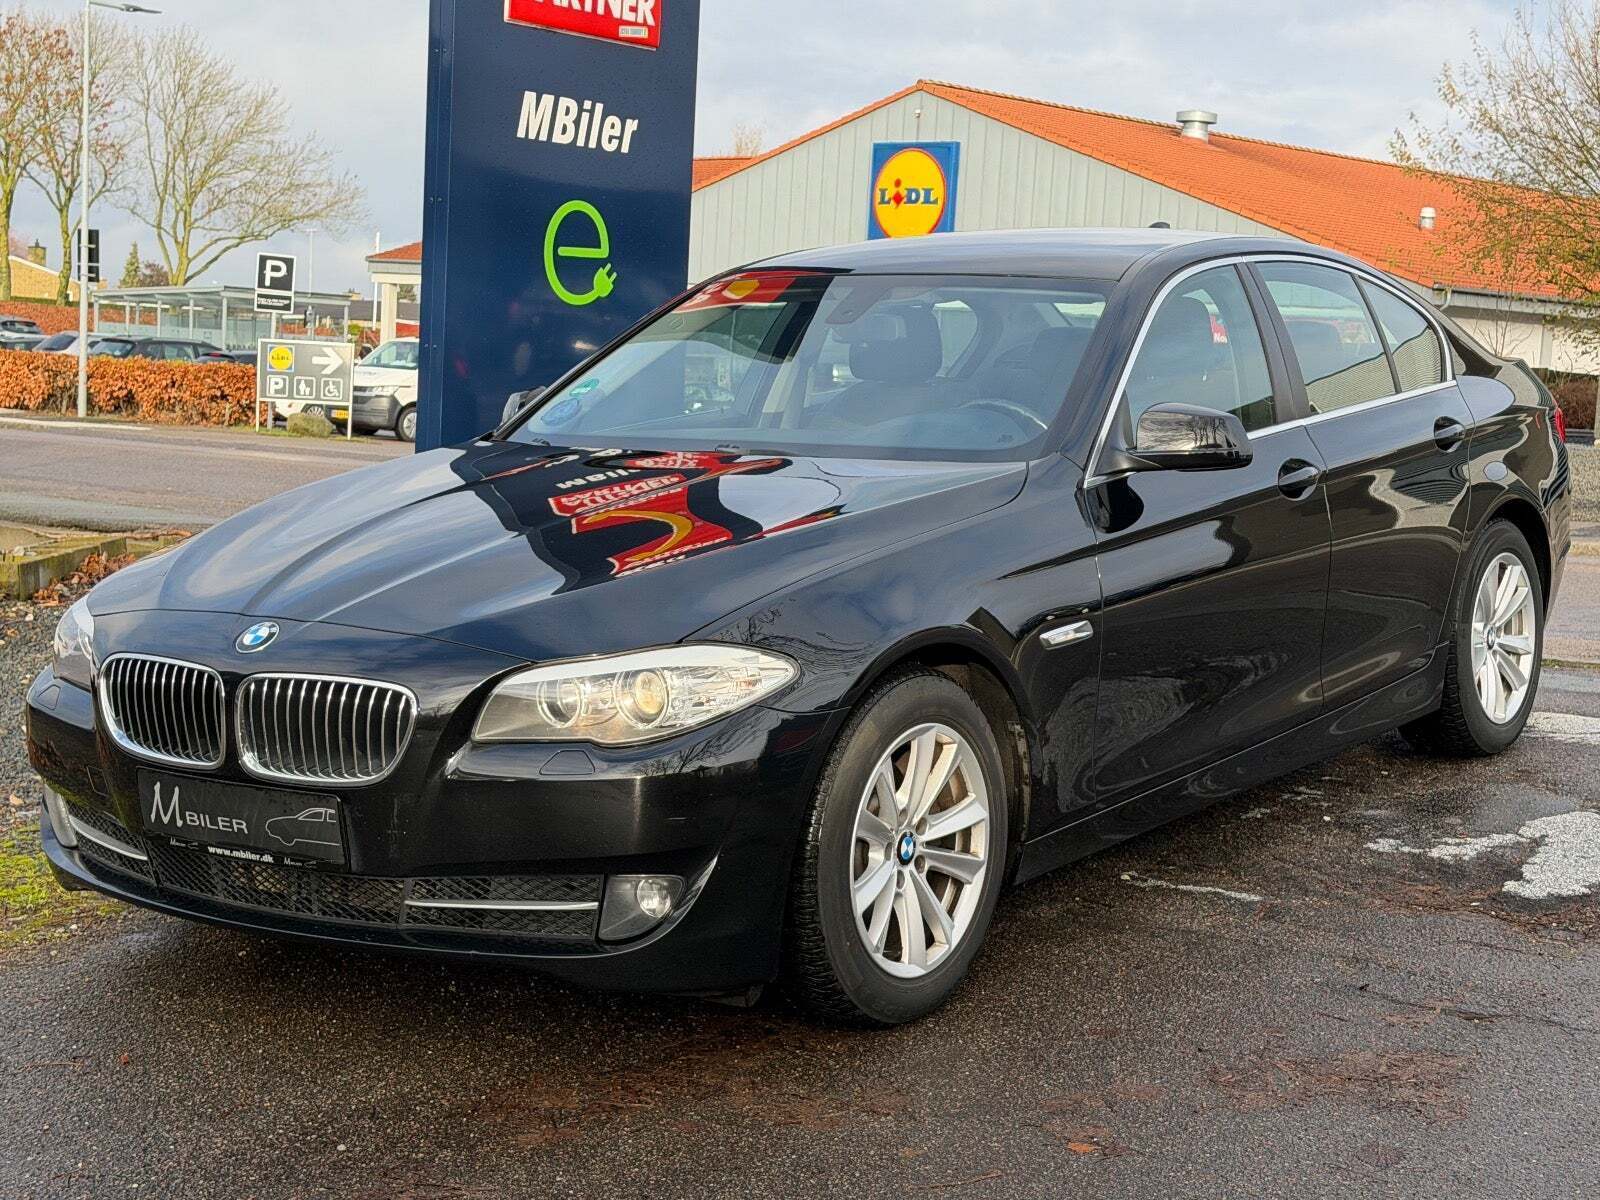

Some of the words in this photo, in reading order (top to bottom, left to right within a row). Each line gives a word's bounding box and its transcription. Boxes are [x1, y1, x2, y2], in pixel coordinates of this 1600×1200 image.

[516, 90, 639, 154] MBiler
[264, 259, 288, 287] P
[269, 378, 284, 395] P
[207, 846, 274, 864] www.mbiler.dk
